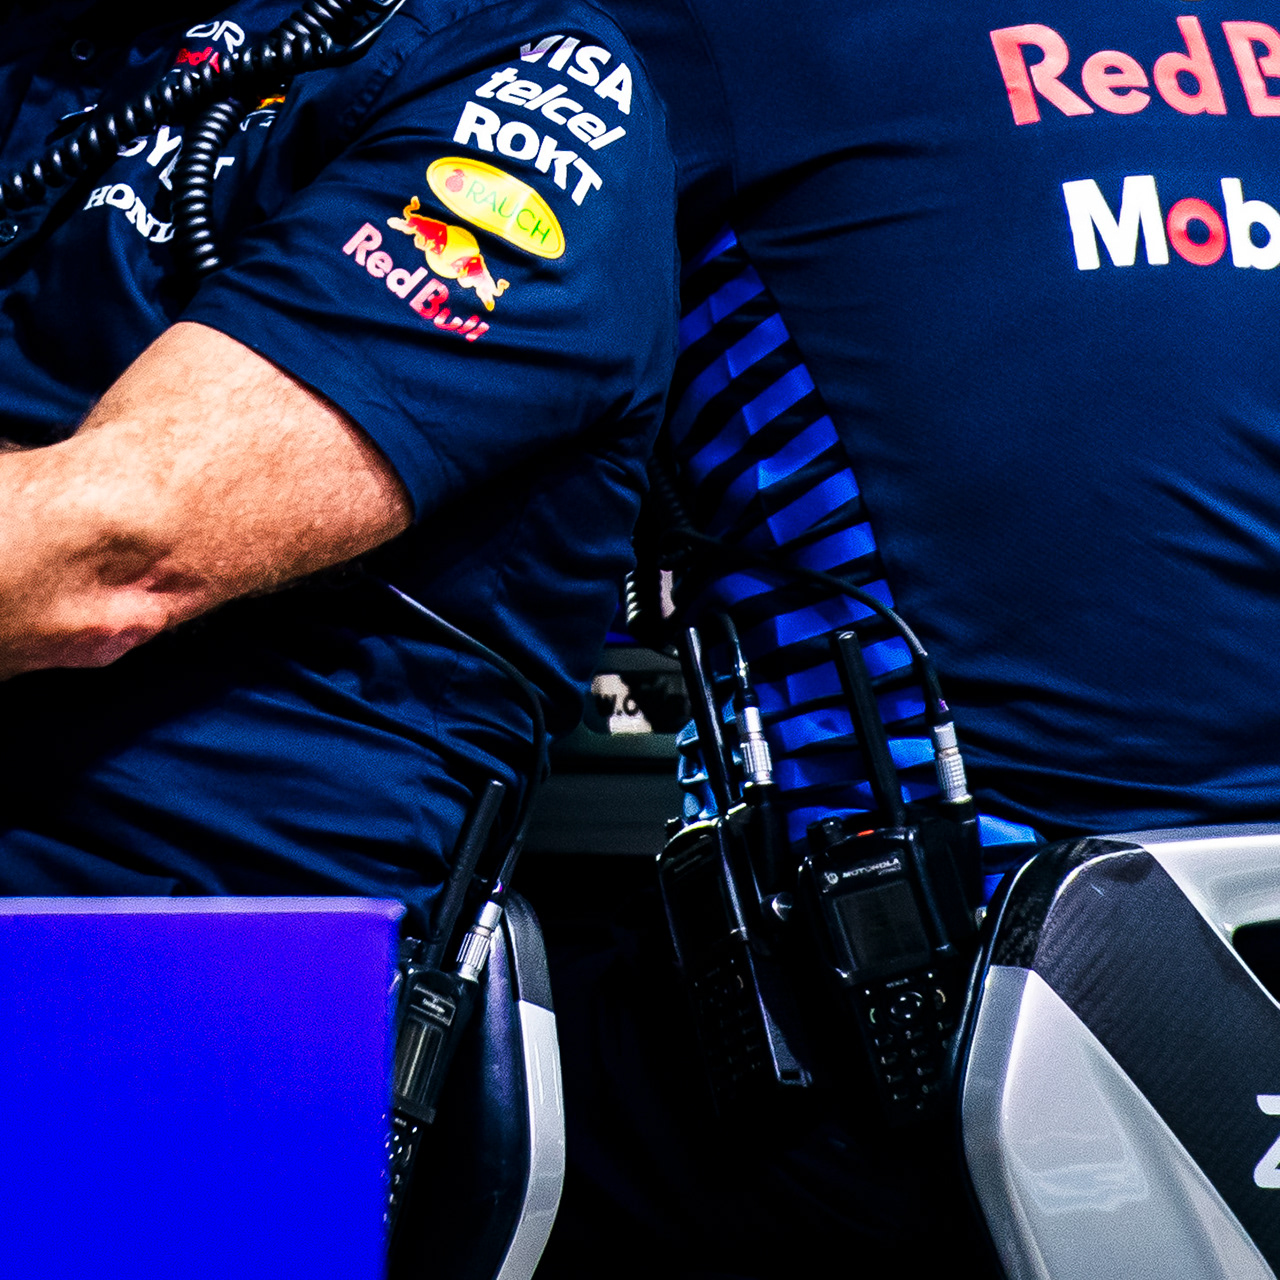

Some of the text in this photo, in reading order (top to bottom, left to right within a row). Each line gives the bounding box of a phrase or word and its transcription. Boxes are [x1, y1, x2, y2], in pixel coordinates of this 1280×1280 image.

[475, 67, 627, 151] telcel
[520, 35, 633, 115] VISA
[989, 15, 1228, 126] Red
[452, 101, 603, 207] ROKT
[466, 180, 551, 245] RAUCH
[342, 222, 490, 342] Red Bull
[842, 857, 901, 878] MOTOROLA
